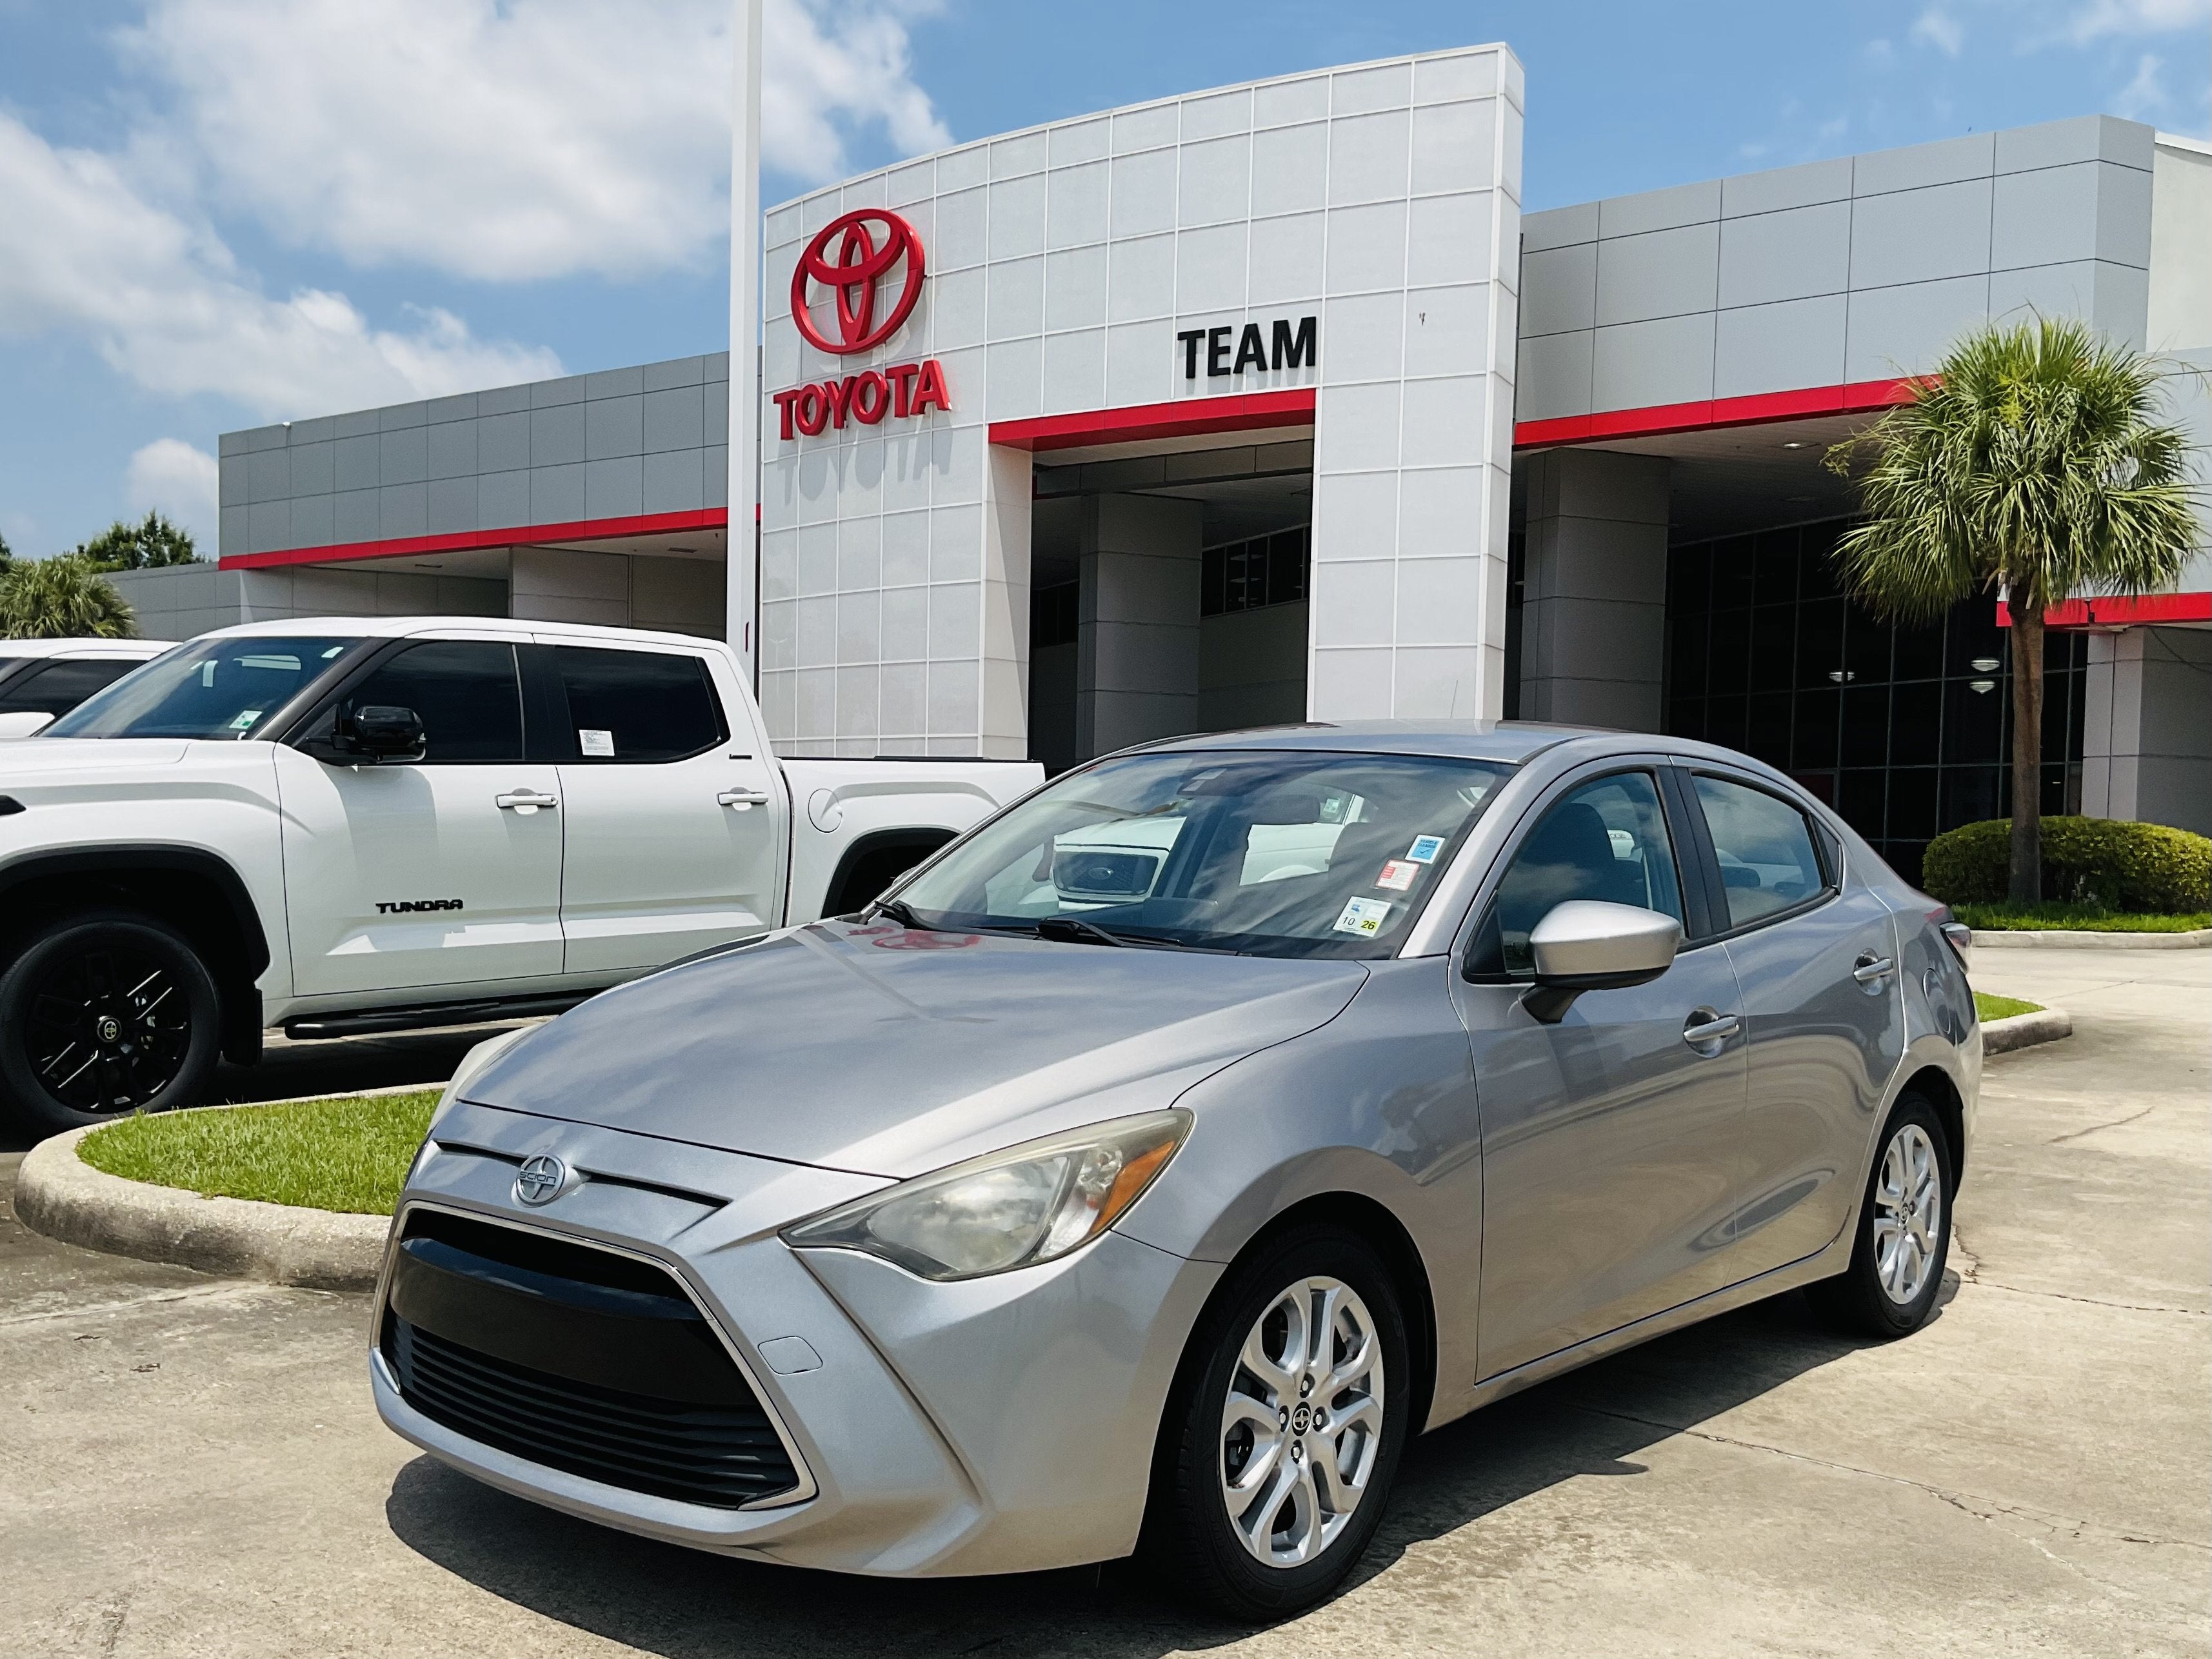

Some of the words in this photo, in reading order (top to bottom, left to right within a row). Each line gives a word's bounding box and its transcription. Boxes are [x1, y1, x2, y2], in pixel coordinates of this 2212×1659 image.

[1177, 316, 1317, 379] TEAM
[773, 360, 952, 441] TOYOTA
[375, 899, 464, 914] TUNDRA
[1342, 917, 1355, 926] 10
[1361, 920, 1376, 929] 26
